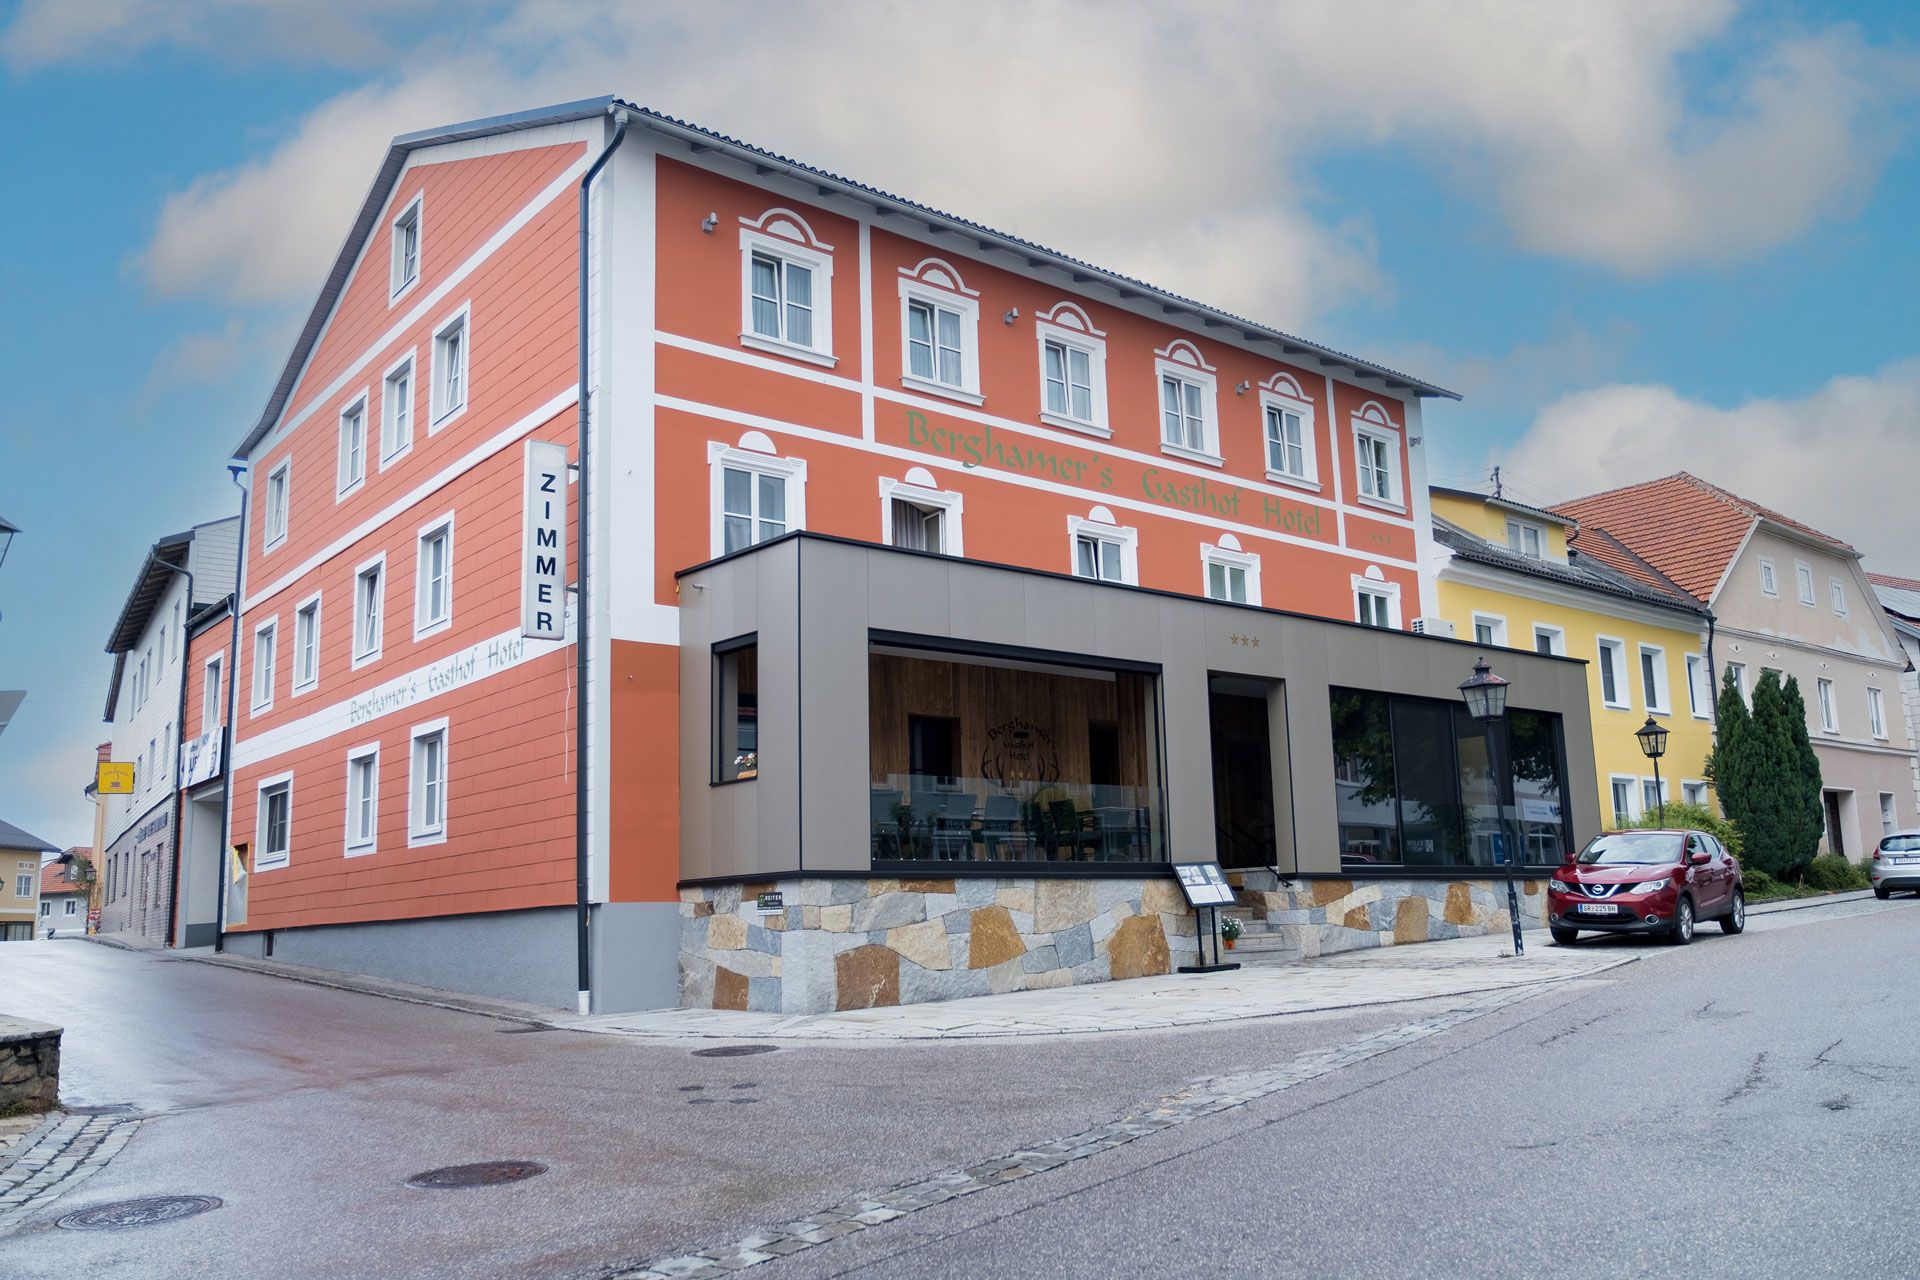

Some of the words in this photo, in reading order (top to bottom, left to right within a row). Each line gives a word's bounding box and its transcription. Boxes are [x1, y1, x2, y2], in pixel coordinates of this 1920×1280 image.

[905, 409, 1114, 490] Berghamer's
[1141, 468, 1243, 517] Gasthof
[1262, 495, 1321, 536] Hotel
[536, 472, 557, 631] ZIMMER
[350, 673, 417, 724] Berghamer's
[428, 646, 478, 694] Gasthof
[487, 637, 524, 670] Hotel
[1009, 751, 1030, 761] Hotel
